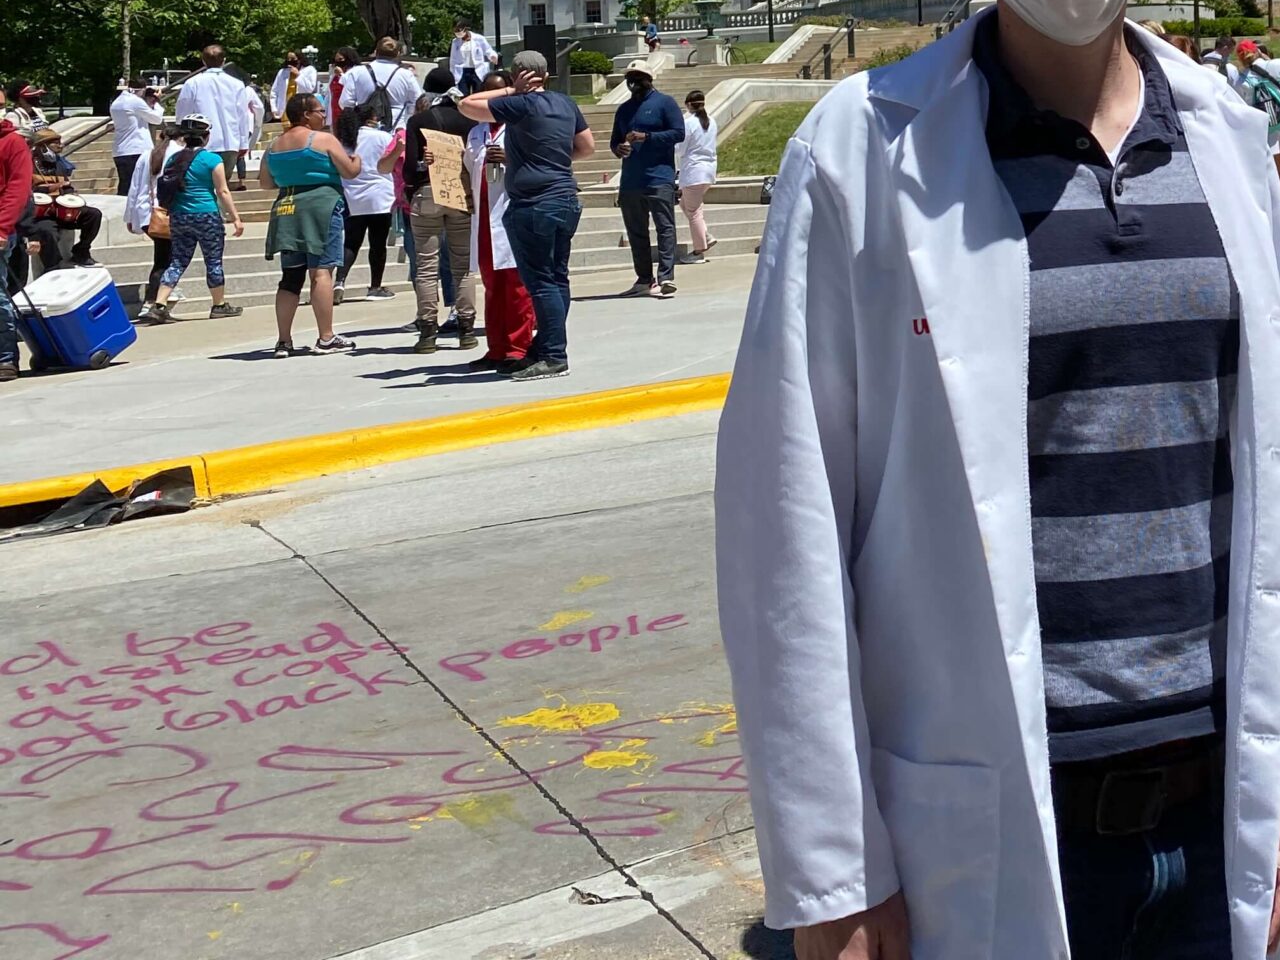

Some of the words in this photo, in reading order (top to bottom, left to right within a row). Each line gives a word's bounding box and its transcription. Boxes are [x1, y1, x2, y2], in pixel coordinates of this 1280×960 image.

[16, 622, 365, 700] instead
[125, 621, 258, 656] be
[9, 684, 212, 728] ask
[232, 641, 411, 687] cops
